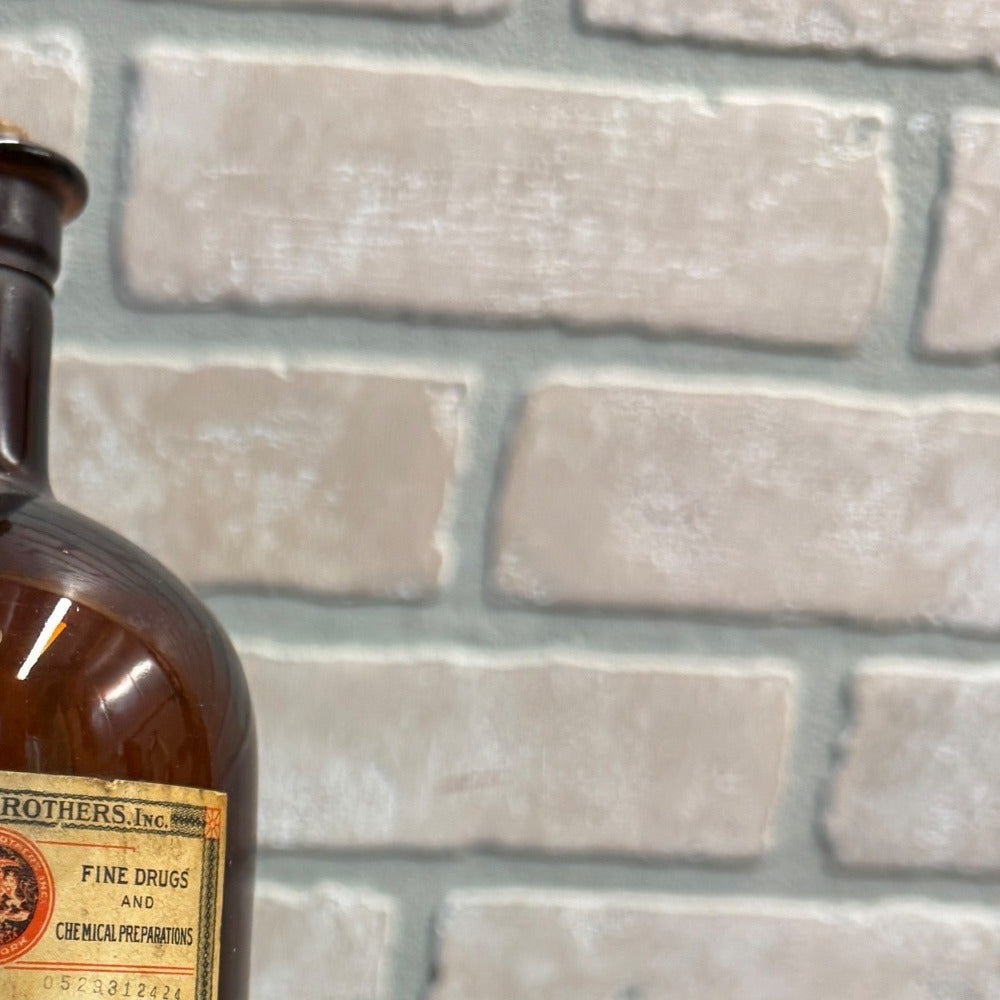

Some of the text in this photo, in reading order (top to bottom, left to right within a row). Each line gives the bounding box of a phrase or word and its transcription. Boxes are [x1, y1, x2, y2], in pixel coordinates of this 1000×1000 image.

[81, 864, 190, 889] FINE DRUGS
[120, 895, 154, 909] AND
[55, 921, 193, 946] CHEMICAL PREPARATIONS
